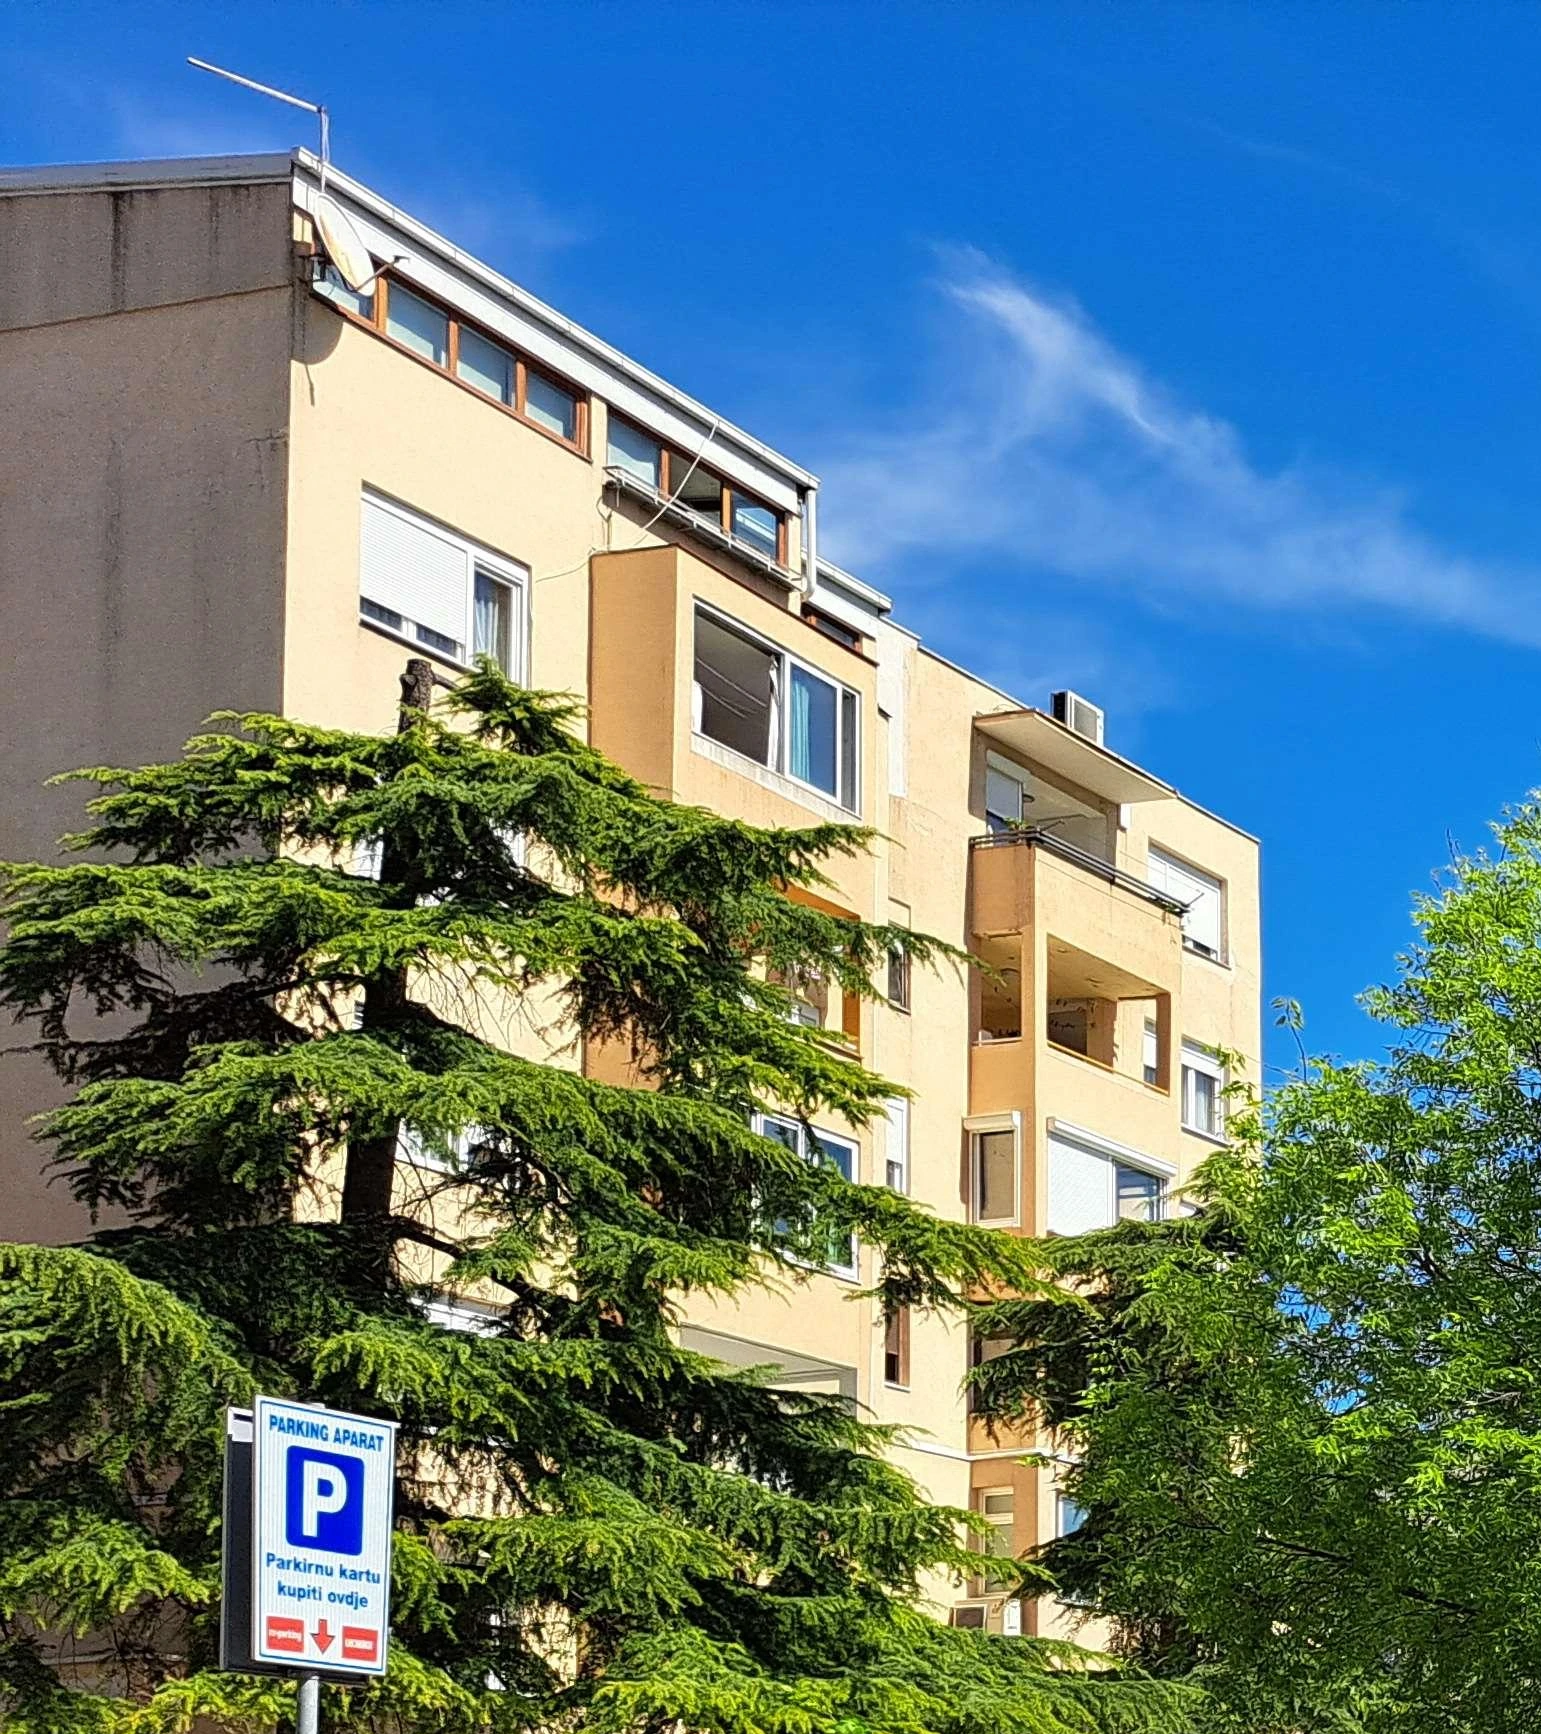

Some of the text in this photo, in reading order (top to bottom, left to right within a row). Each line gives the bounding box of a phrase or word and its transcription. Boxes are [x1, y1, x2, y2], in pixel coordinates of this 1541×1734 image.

[269, 1415, 384, 1453] PARKING APARAT
[302, 1459, 347, 1538] P
[266, 1552, 381, 1585] Parkirnu kartu
[277, 1580, 369, 1611] kupiti ovdje
